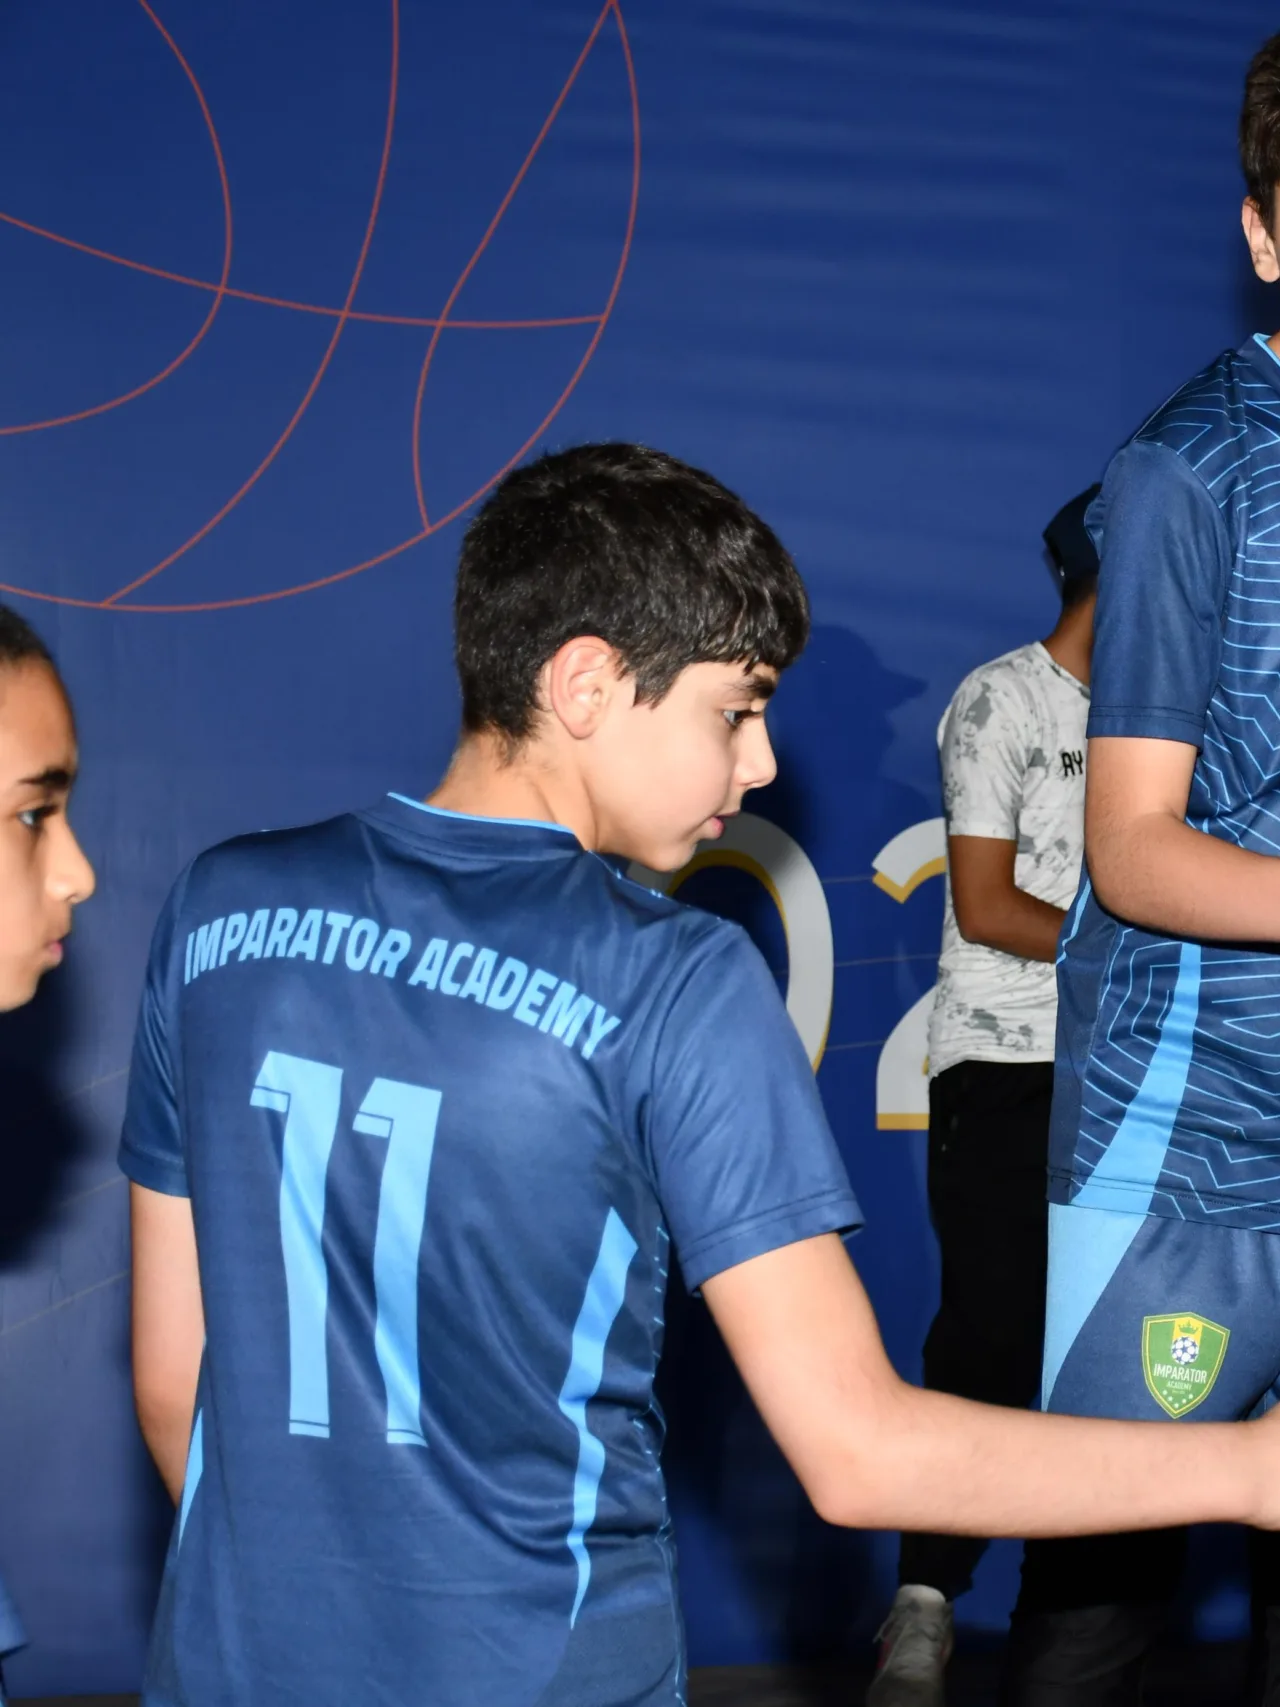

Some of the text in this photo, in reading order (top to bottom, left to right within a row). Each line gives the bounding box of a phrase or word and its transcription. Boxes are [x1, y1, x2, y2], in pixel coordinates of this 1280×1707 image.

[184, 907, 621, 1060] IMPARATOR ACADEMY
[249, 1050, 443, 1447] 11
[1153, 1363, 1208, 1384] IMPARATOR
